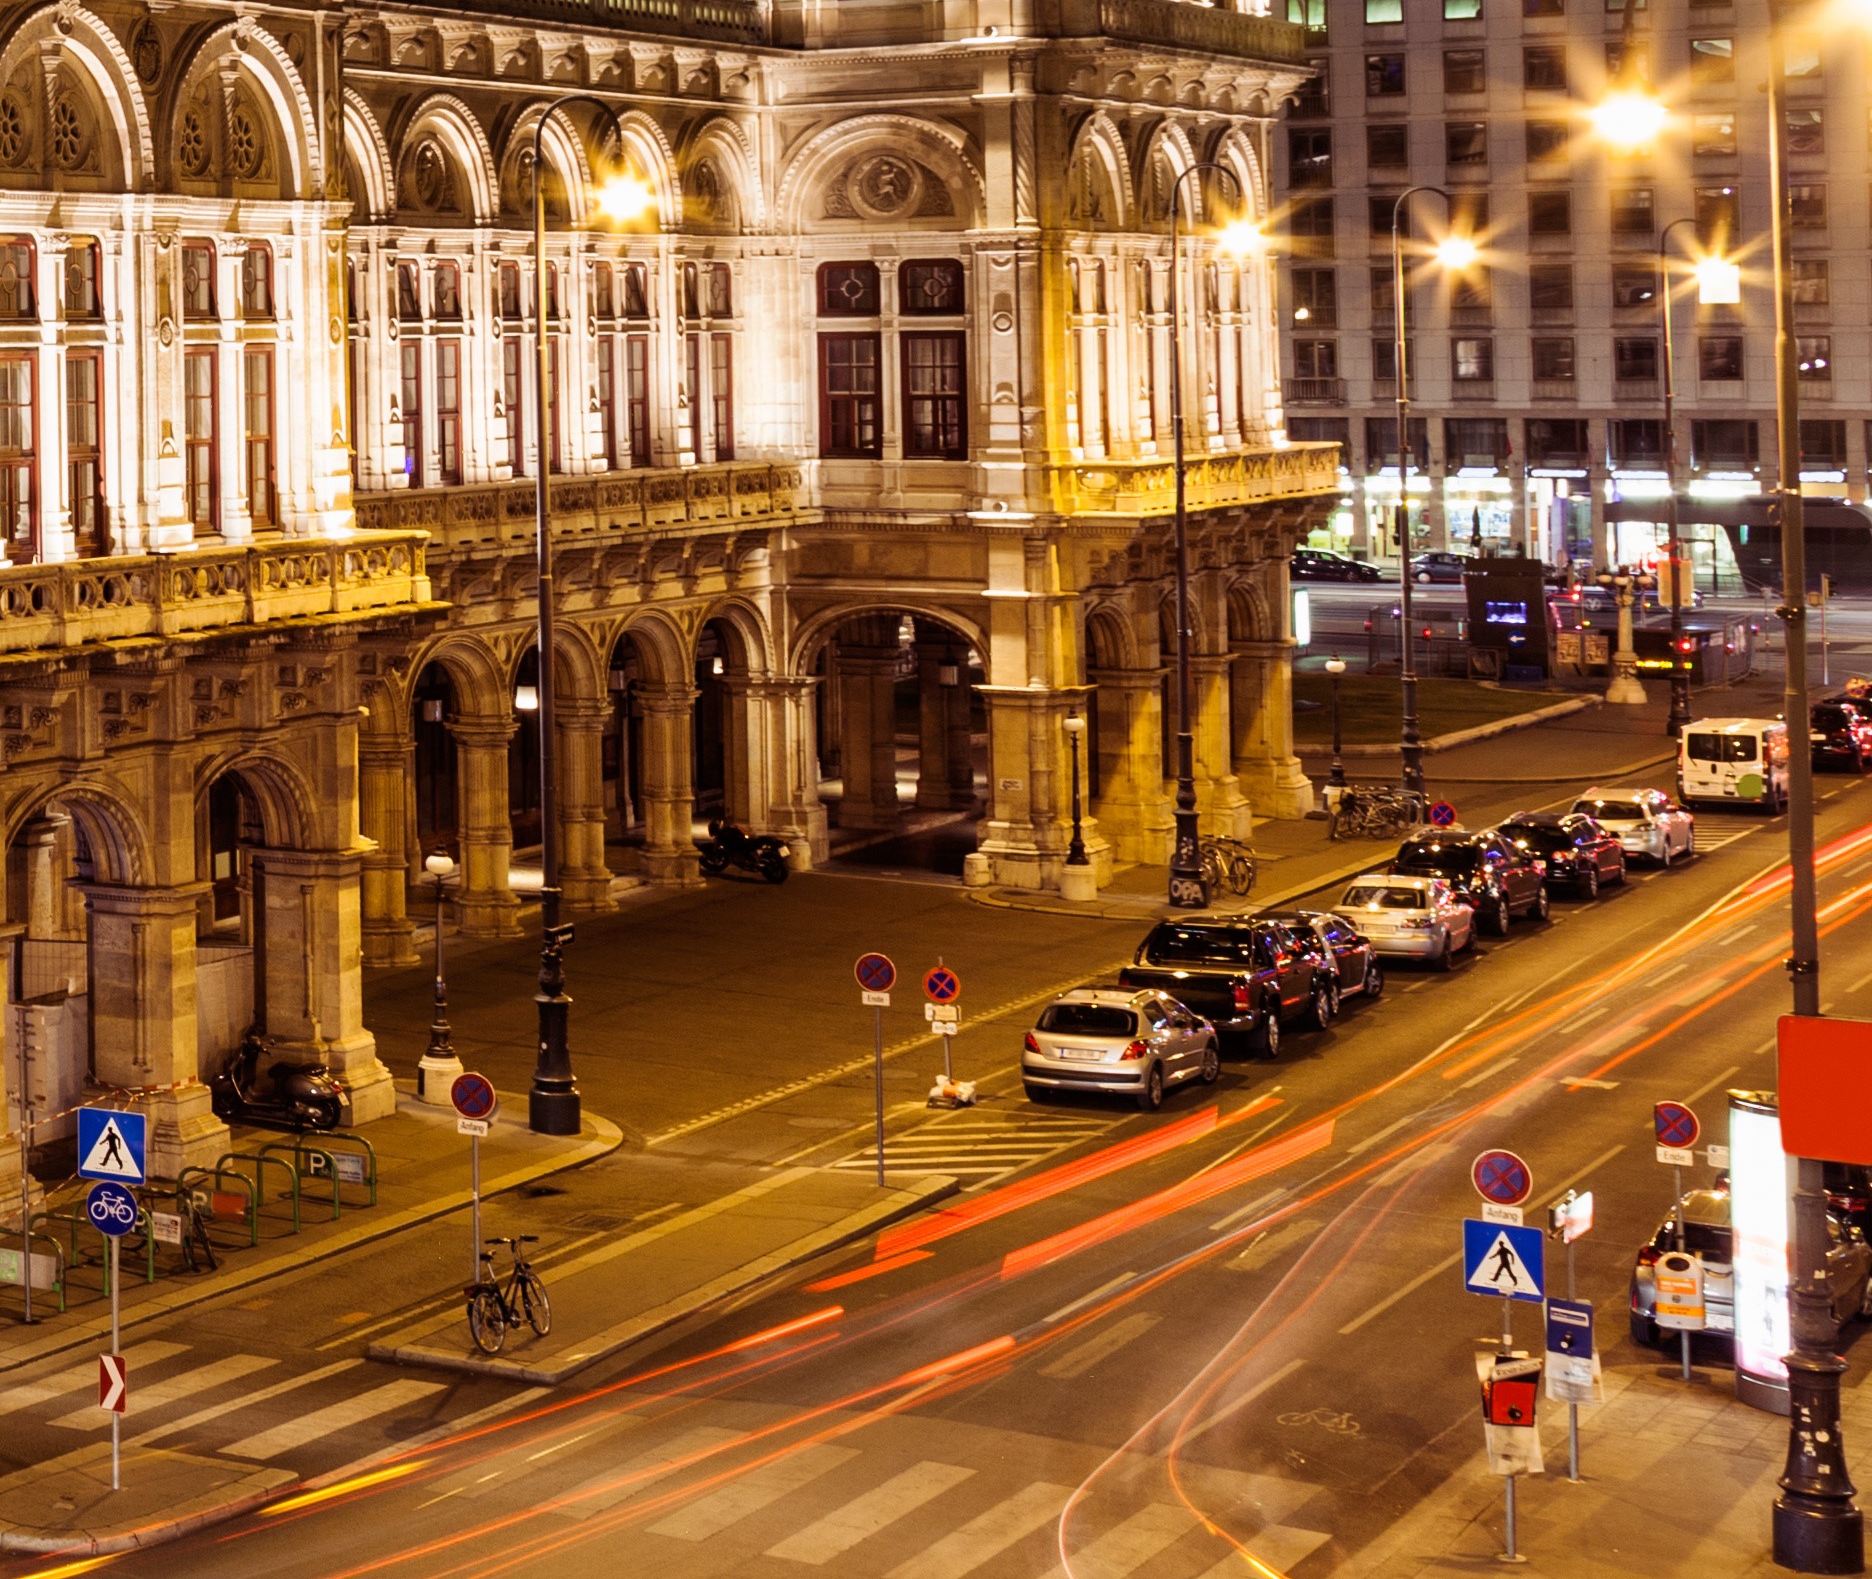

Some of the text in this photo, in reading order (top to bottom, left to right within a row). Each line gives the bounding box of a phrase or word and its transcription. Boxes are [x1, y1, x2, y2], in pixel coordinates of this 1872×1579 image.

[1171, 880, 1204, 902] OPA
[310, 1153, 325, 1174] P
[1487, 1207, 1518, 1223] Anfang
